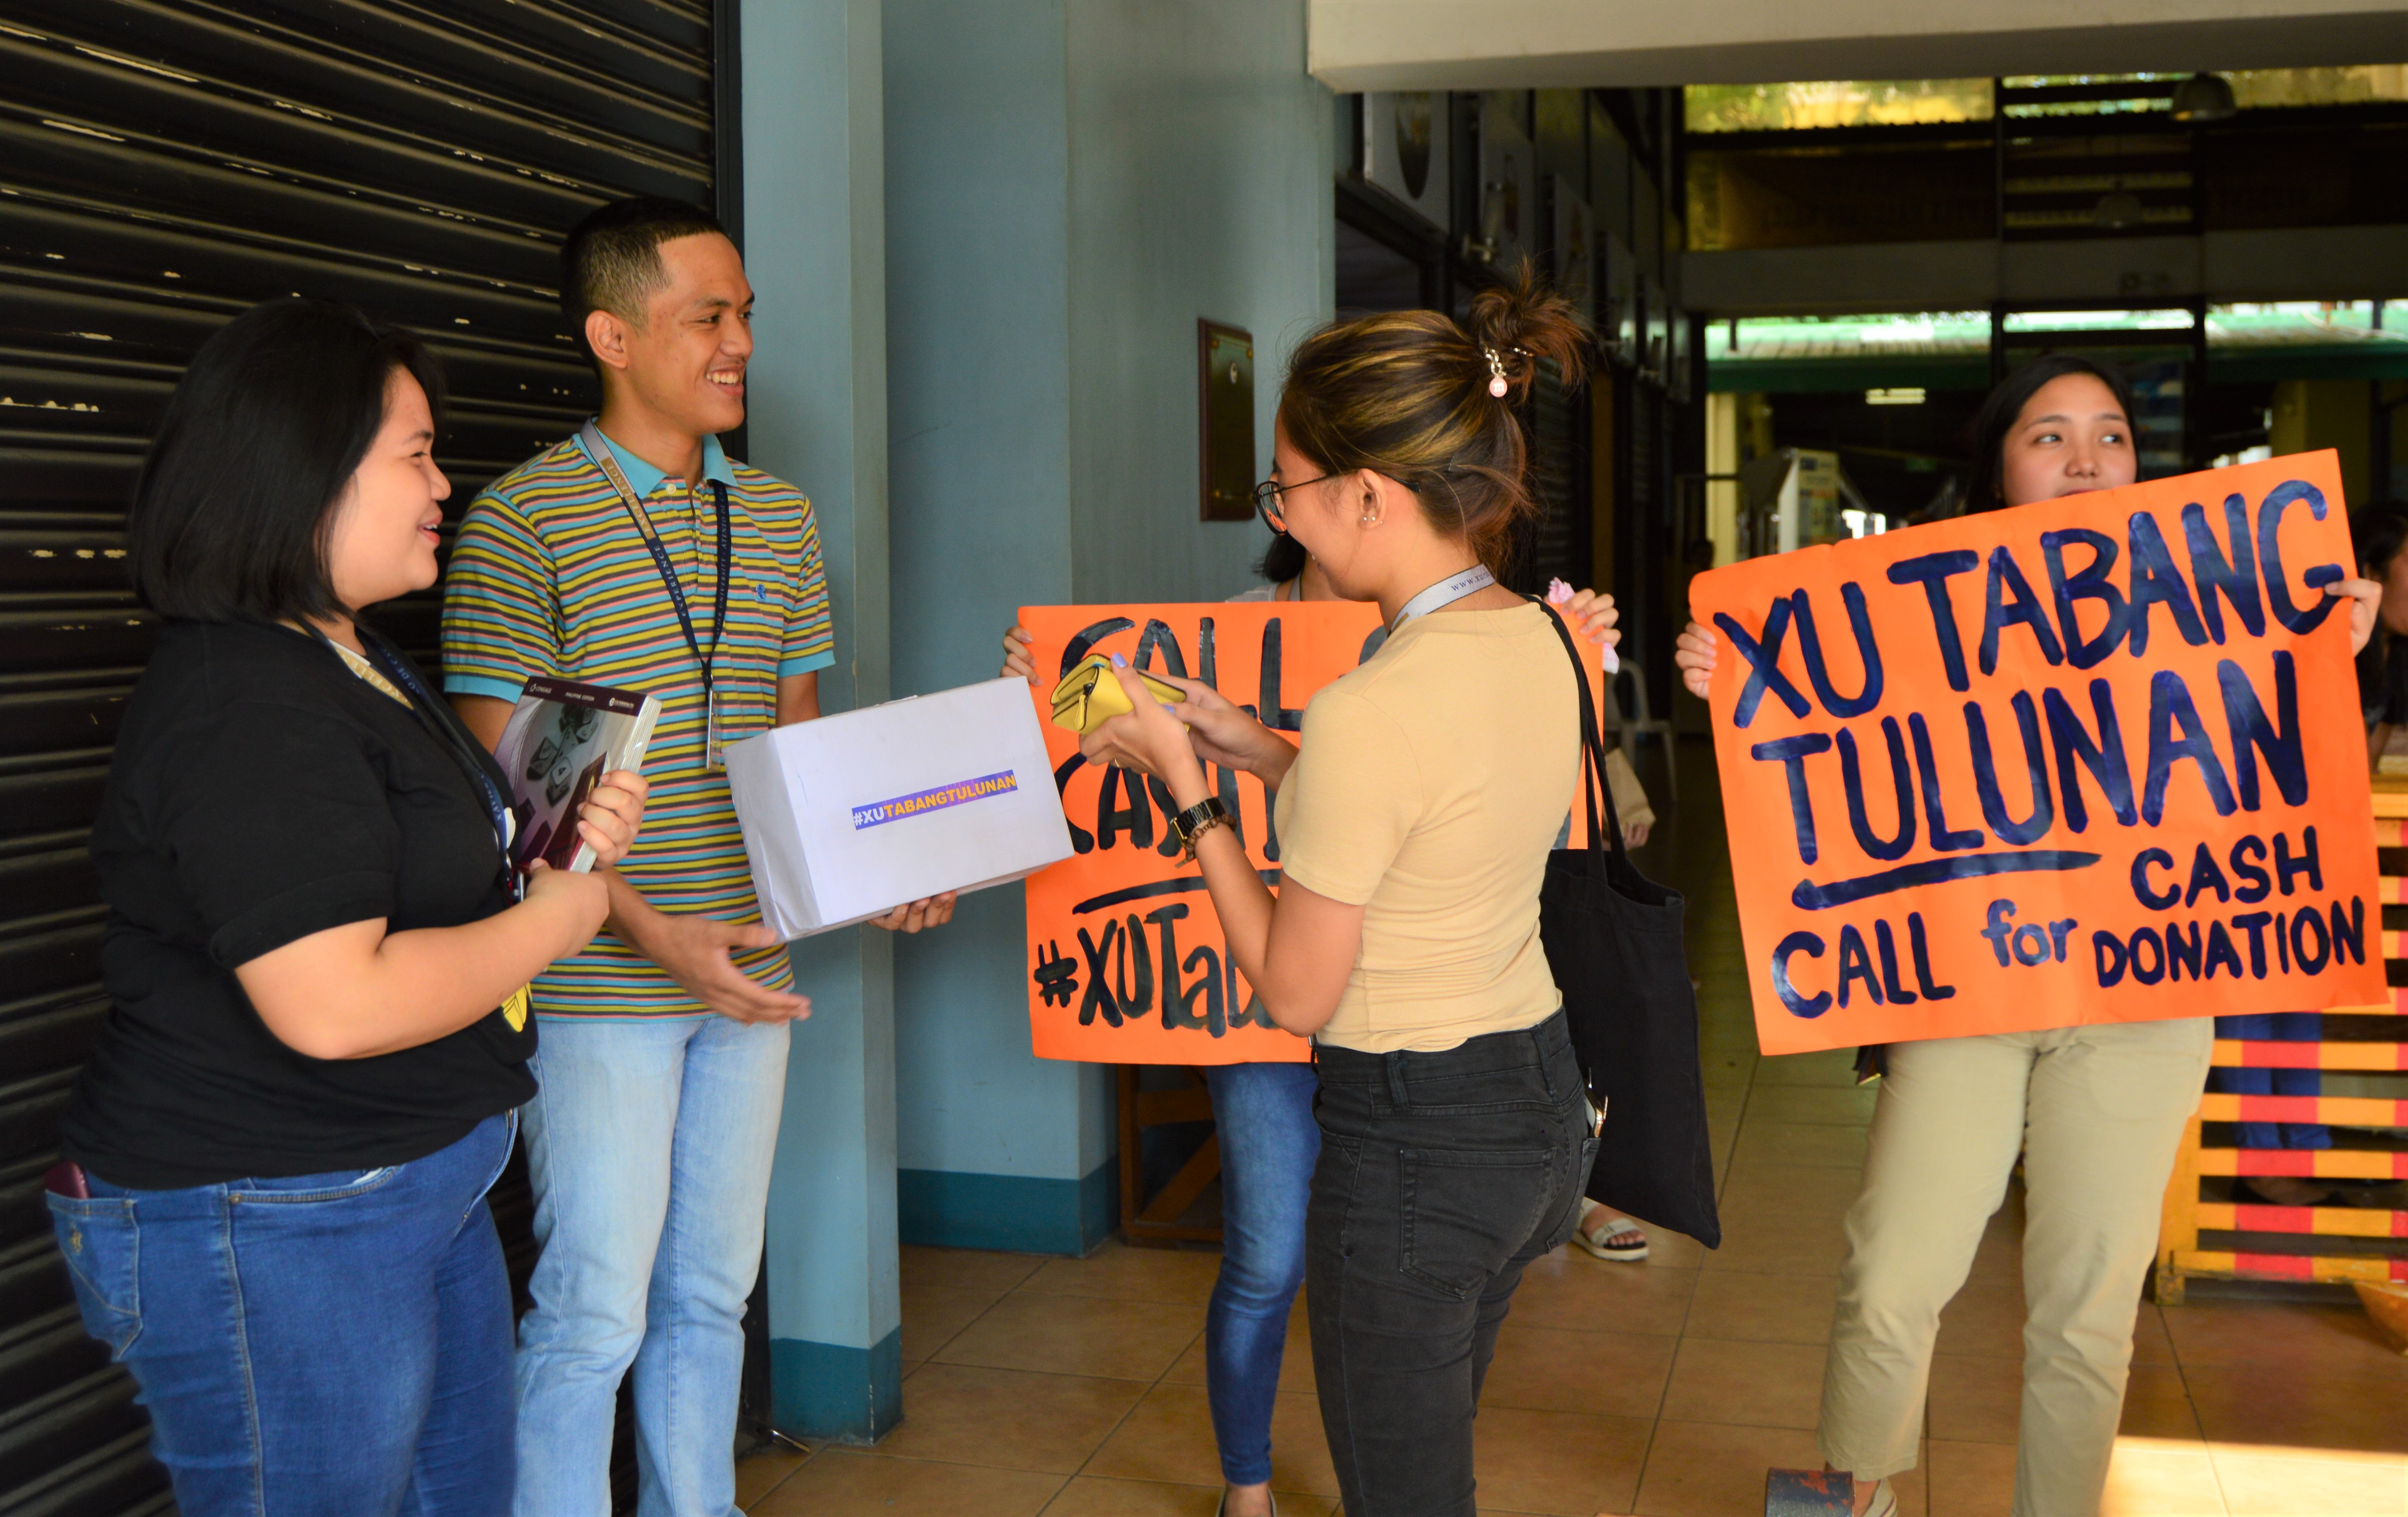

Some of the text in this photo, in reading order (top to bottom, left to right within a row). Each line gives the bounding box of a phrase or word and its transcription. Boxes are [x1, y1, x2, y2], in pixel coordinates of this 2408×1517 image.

[606, 461, 686, 617] EXPERIENCE EXCELLENCE
[720, 504, 726, 515] DE
[1713, 480, 2344, 727] XU TABANG
[535, 685, 552, 694] CENGAGE
[853, 775, 1016, 826] #XUTABANGTULUNAN
[1751, 651, 2307, 865] TULUNAN
[2131, 826, 2323, 910] CASH
[1771, 896, 2365, 1018] CALL for DONATION
